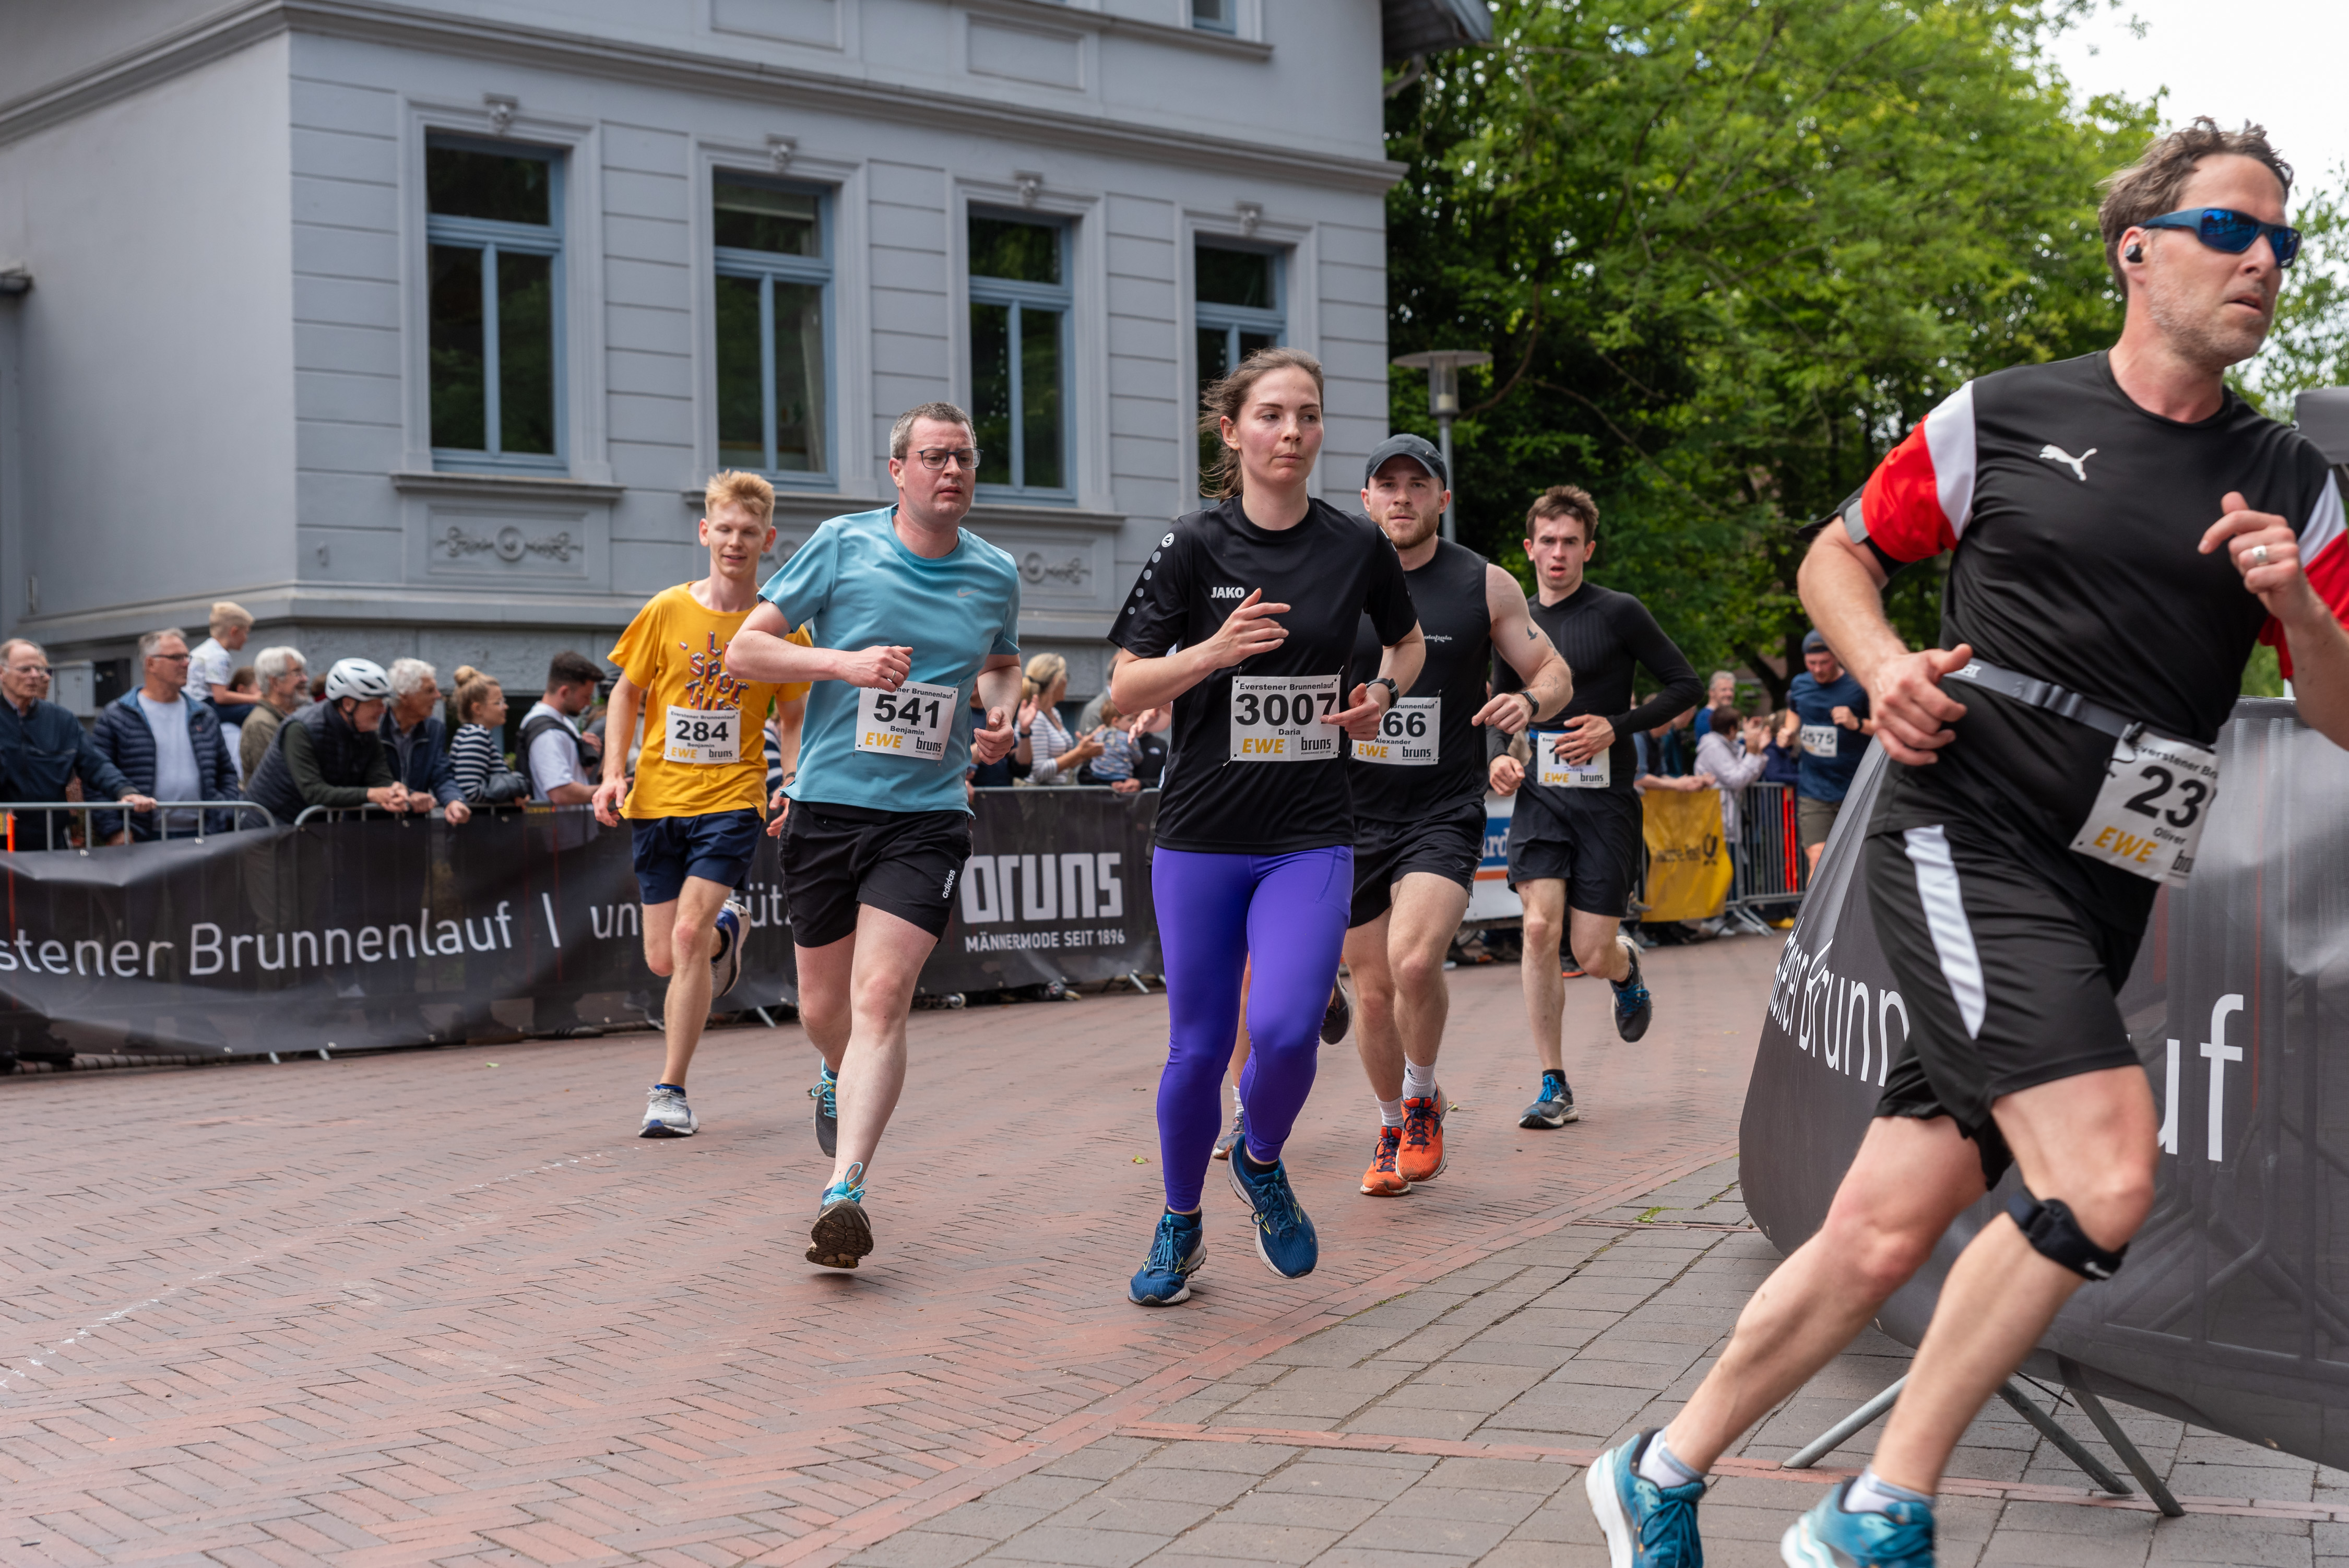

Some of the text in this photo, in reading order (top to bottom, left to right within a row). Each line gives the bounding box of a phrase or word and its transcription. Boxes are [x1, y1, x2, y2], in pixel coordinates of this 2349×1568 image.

[1211, 587, 1245, 598] JAKO
[911, 688, 953, 699] Brunnenlauf
[1289, 682, 1334, 691] Brunnenlauf
[873, 693, 940, 729] 541
[1235, 692, 1337, 726] 3007
[675, 719, 729, 742] 284
[890, 726, 925, 735] Benjamin
[1378, 711, 1426, 738] 66
[671, 746, 733, 759] EWE bruns
[865, 732, 942, 752] EWE bruns
[1242, 737, 1332, 754] EWE bruns
[1358, 743, 1431, 758] EWE bruns
[2137, 745, 2199, 772] verstener
[1544, 772, 1604, 783] EWE bruns
[2123, 765, 2209, 828] 23
[2093, 826, 2159, 863] EWE
[2153, 827, 2187, 845] Oliver
[942, 869, 956, 898] adidas
[0, 900, 513, 978] stener Brunnenlauf
[966, 928, 1126, 953] MÄNNERMODE SEIT 1896
